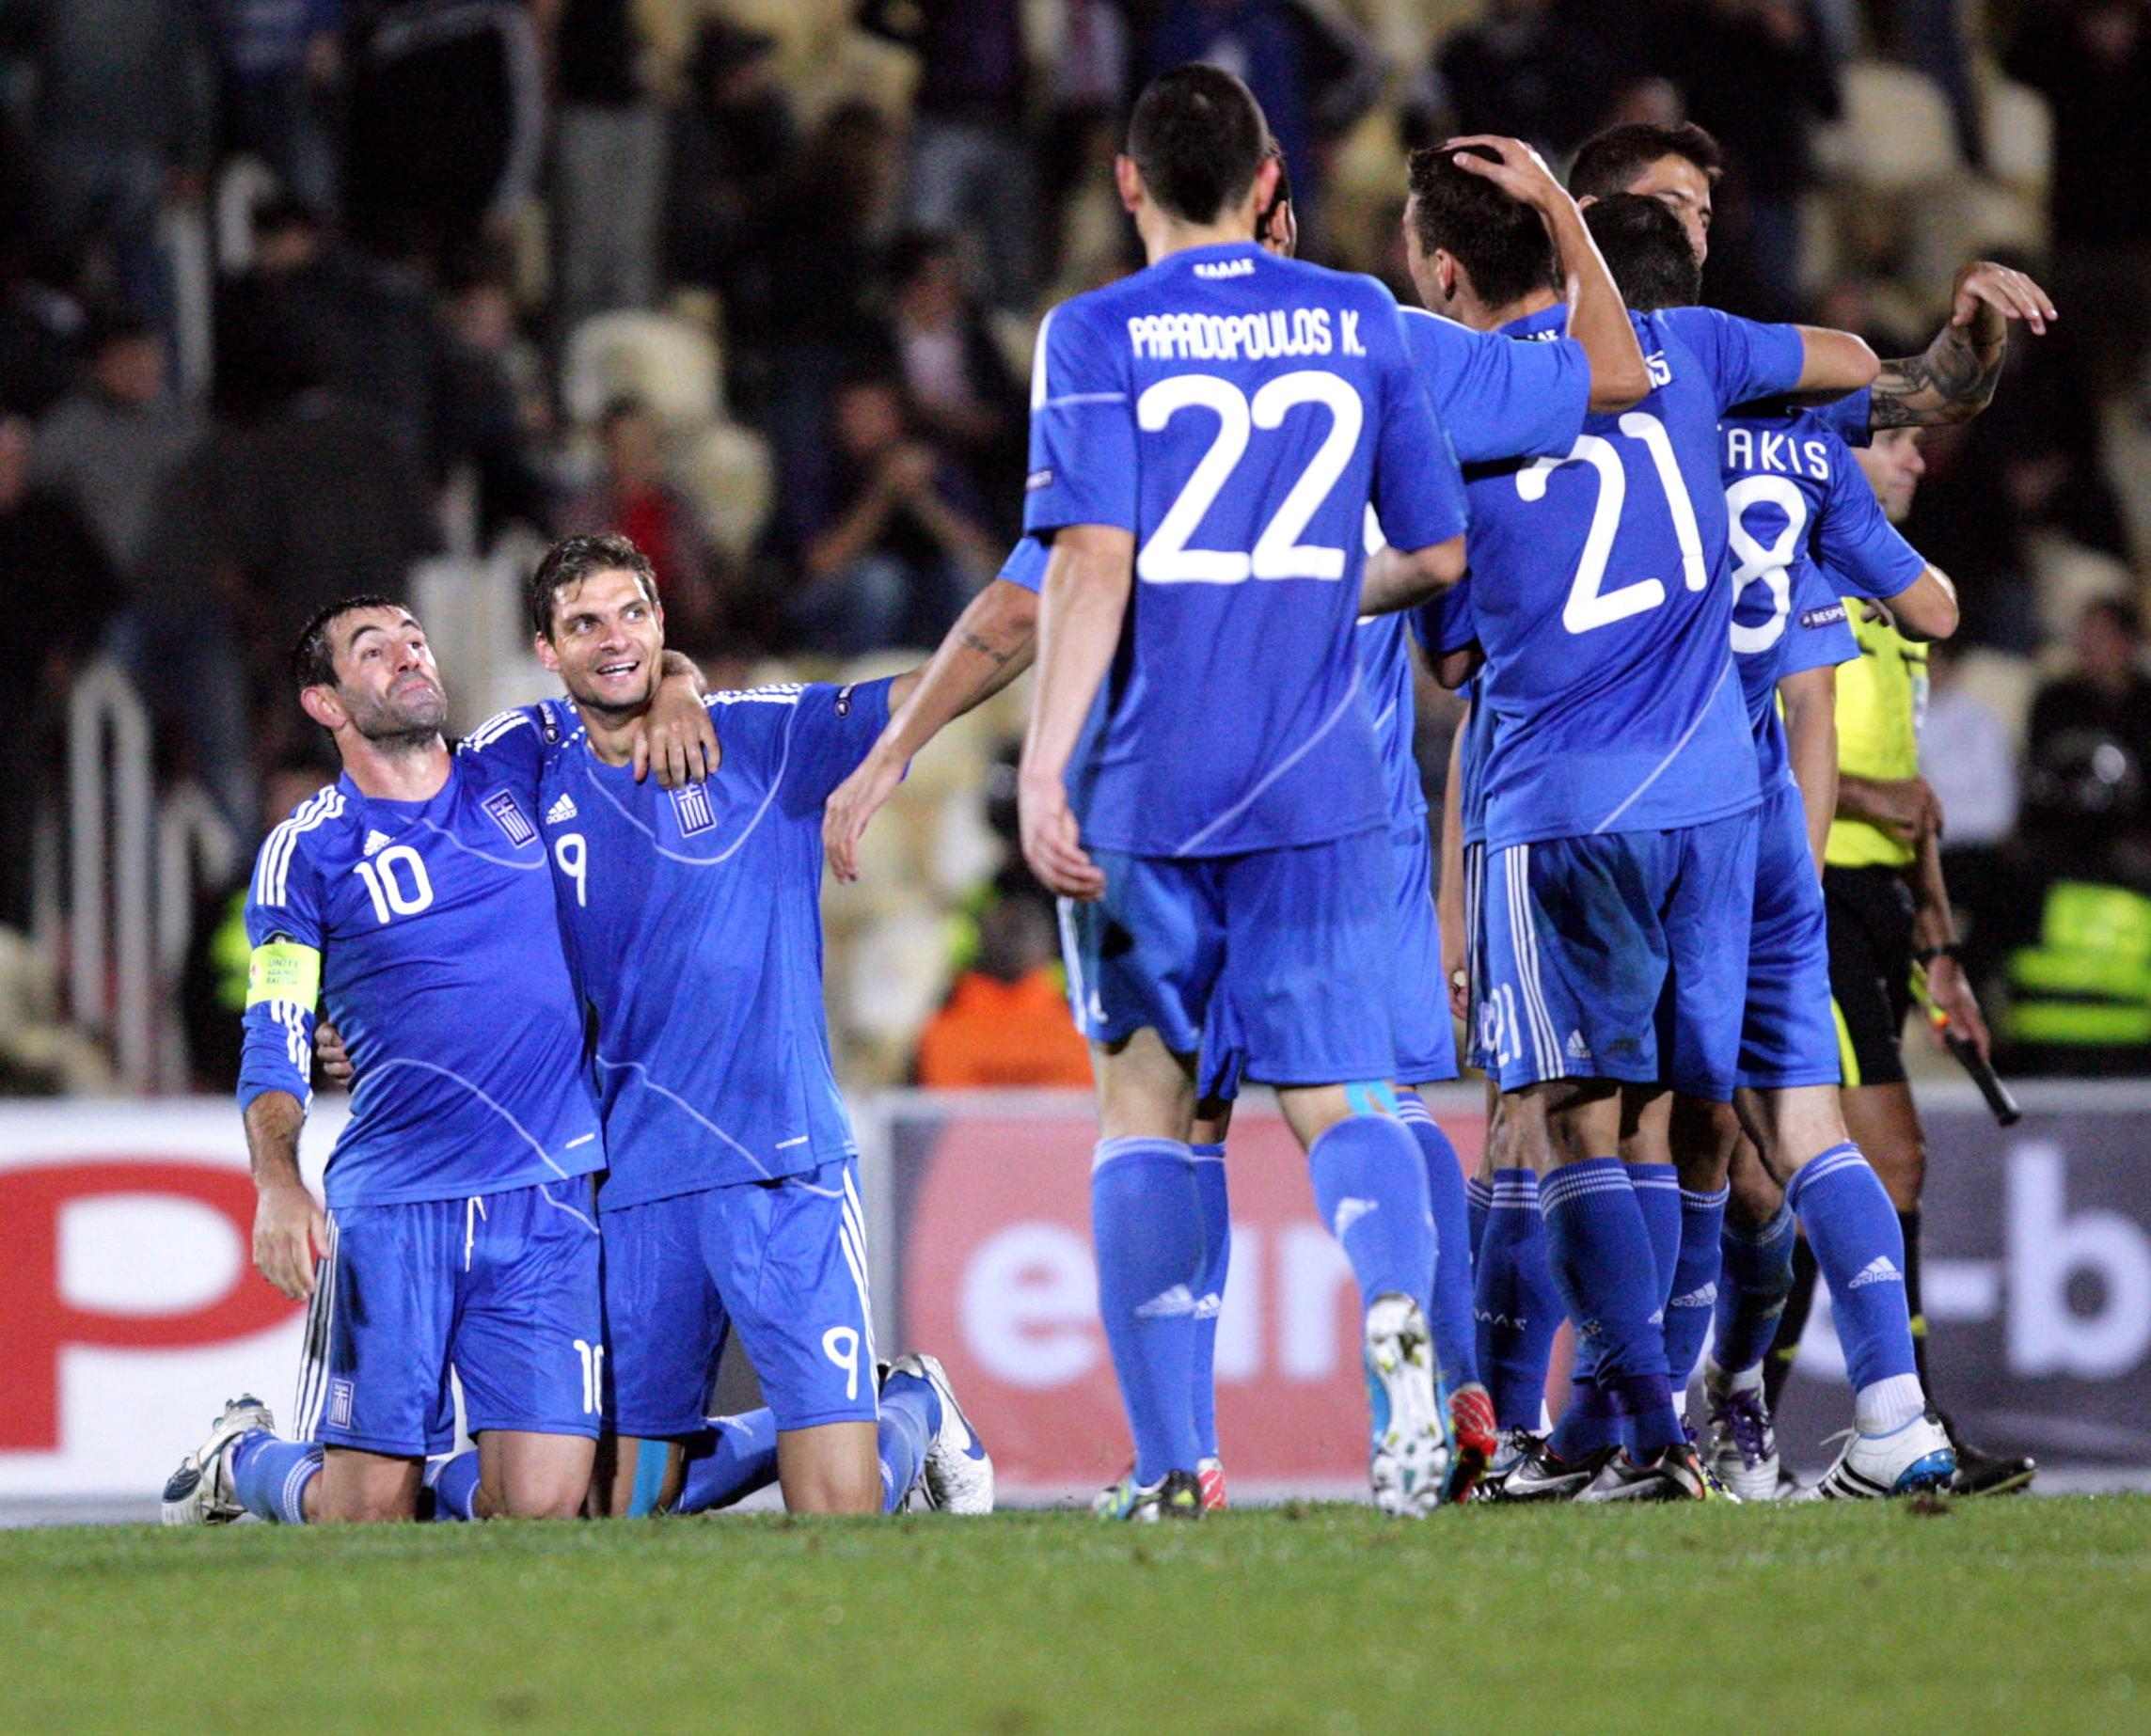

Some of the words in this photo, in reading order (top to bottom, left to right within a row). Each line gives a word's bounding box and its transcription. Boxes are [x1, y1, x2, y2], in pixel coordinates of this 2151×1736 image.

[1128, 307, 1332, 360] PAPADOPOULOS
[1340, 308, 1367, 357] K.
[1137, 370, 1364, 584] 22
[1717, 423, 1829, 480] AKIS
[1515, 411, 1708, 635] 21
[352, 844, 435, 924] 10
[555, 832, 588, 908] 9
[822, 1326, 860, 1401] 9
